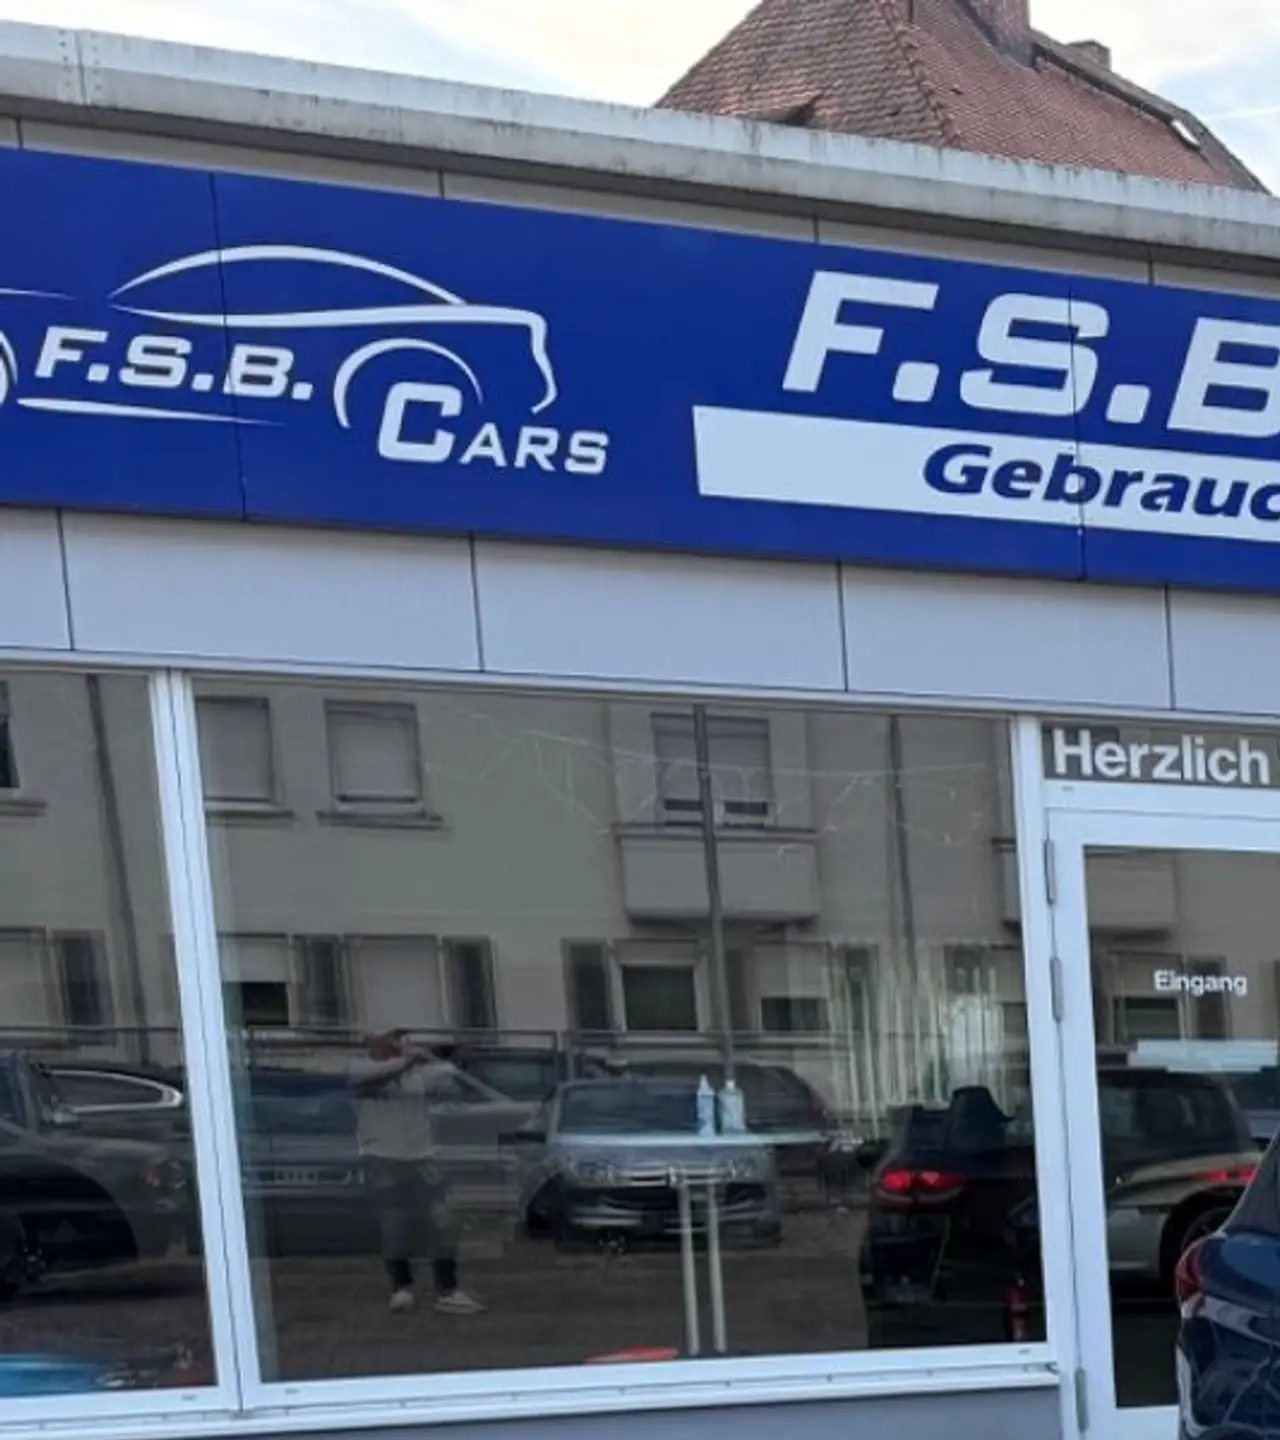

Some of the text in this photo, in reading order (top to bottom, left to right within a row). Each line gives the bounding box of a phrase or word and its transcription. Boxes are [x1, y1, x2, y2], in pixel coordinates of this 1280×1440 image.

[35, 325, 313, 399] F.S.B.
[378, 382, 609, 474] CARS
[1051, 728, 1271, 786] Herzlich
[1154, 968, 1248, 997] Eingang
